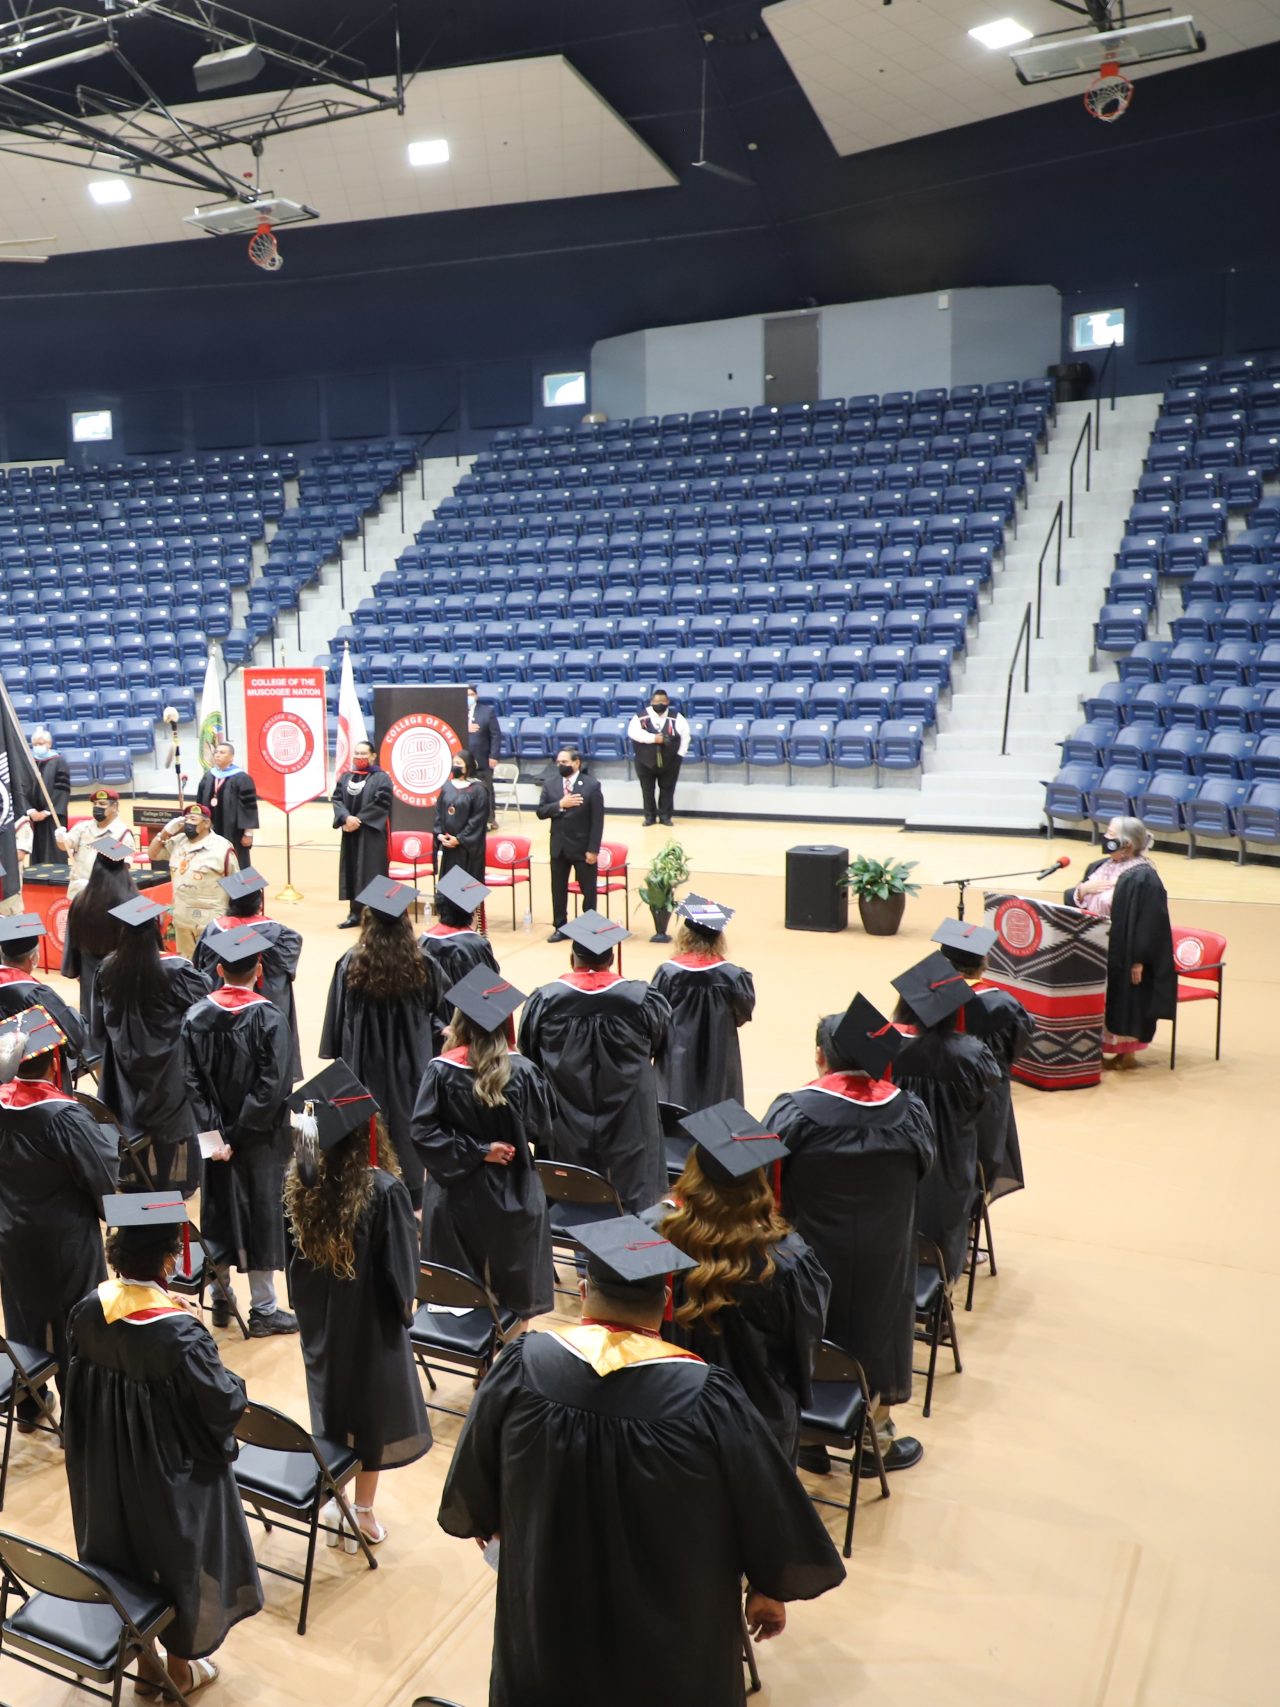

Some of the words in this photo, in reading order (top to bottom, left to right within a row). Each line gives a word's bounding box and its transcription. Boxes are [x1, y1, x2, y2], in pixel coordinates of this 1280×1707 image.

[251, 678, 287, 686] COLLEGE
[288, 678, 300, 686] OF
[300, 678, 316, 686] THE
[247, 688, 291, 696] MUSCOGEE
[292, 688, 321, 696] NATION
[385, 716, 422, 744] COLLEGE
[425, 717, 439, 727] OF
[440, 726, 458, 745] THE
